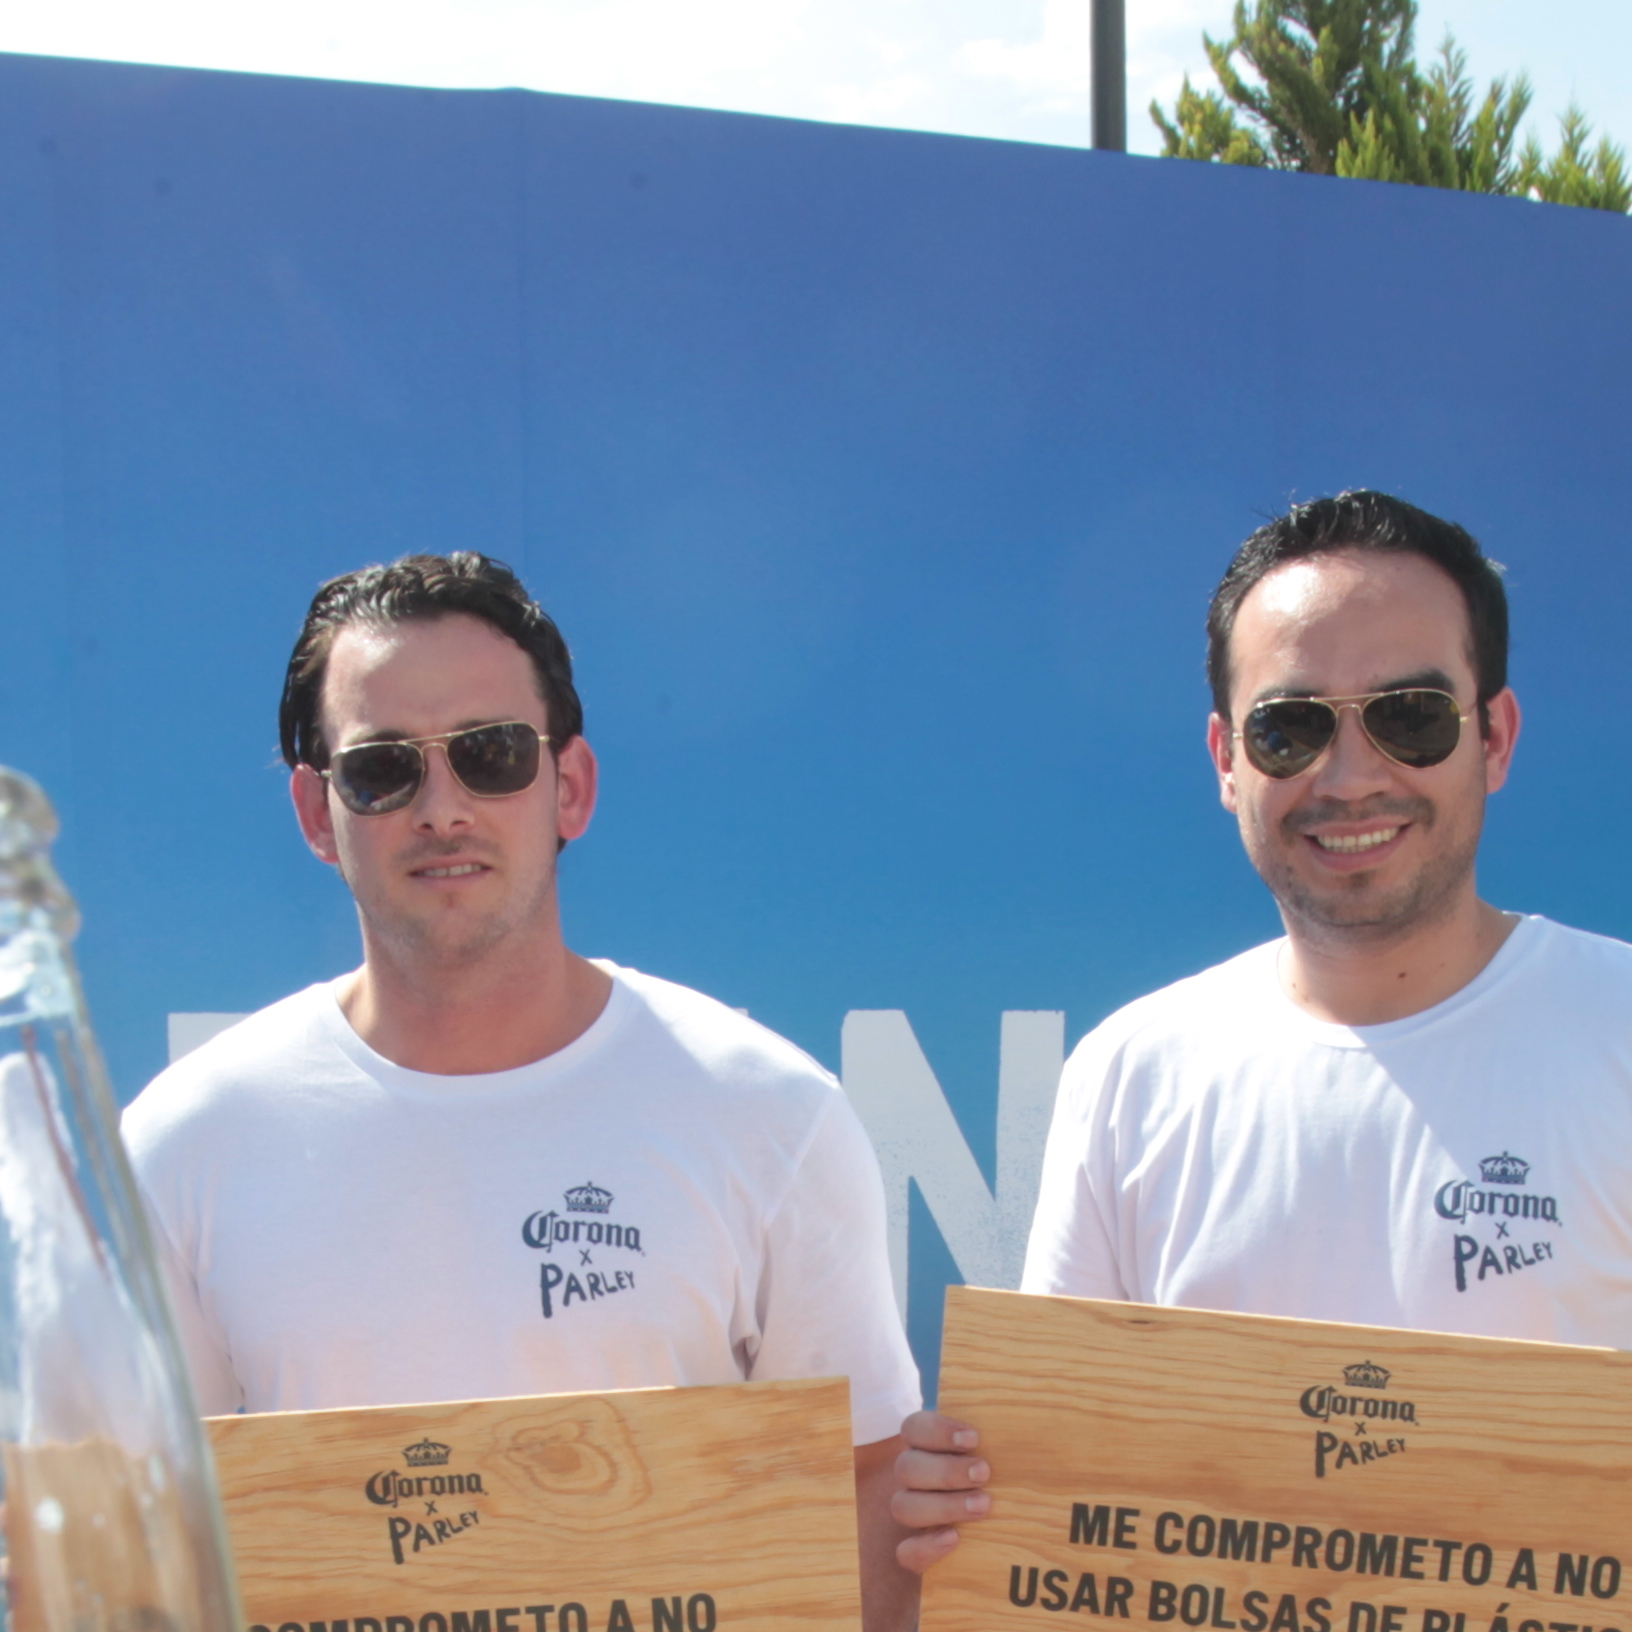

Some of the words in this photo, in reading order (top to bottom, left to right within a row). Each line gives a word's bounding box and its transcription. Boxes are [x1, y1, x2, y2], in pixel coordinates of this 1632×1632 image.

[1433, 1179, 1560, 1226] Corona
[522, 1209, 643, 1254] Corona
[1453, 1233, 1554, 1293] PARLEY
[539, 1262, 636, 1319] PARLEY
[1299, 1384, 1418, 1427] Corona
[1314, 1430, 1408, 1479] PARLEY
[364, 1467, 487, 1508] Corona
[387, 1508, 481, 1565] PARLEY
[1068, 1502, 1141, 1550] ME
[1153, 1510, 1494, 1590] COMPROMETO
[1505, 1547, 1540, 1594] A
[1554, 1552, 1623, 1600] NO
[1008, 1564, 1132, 1620] USAR
